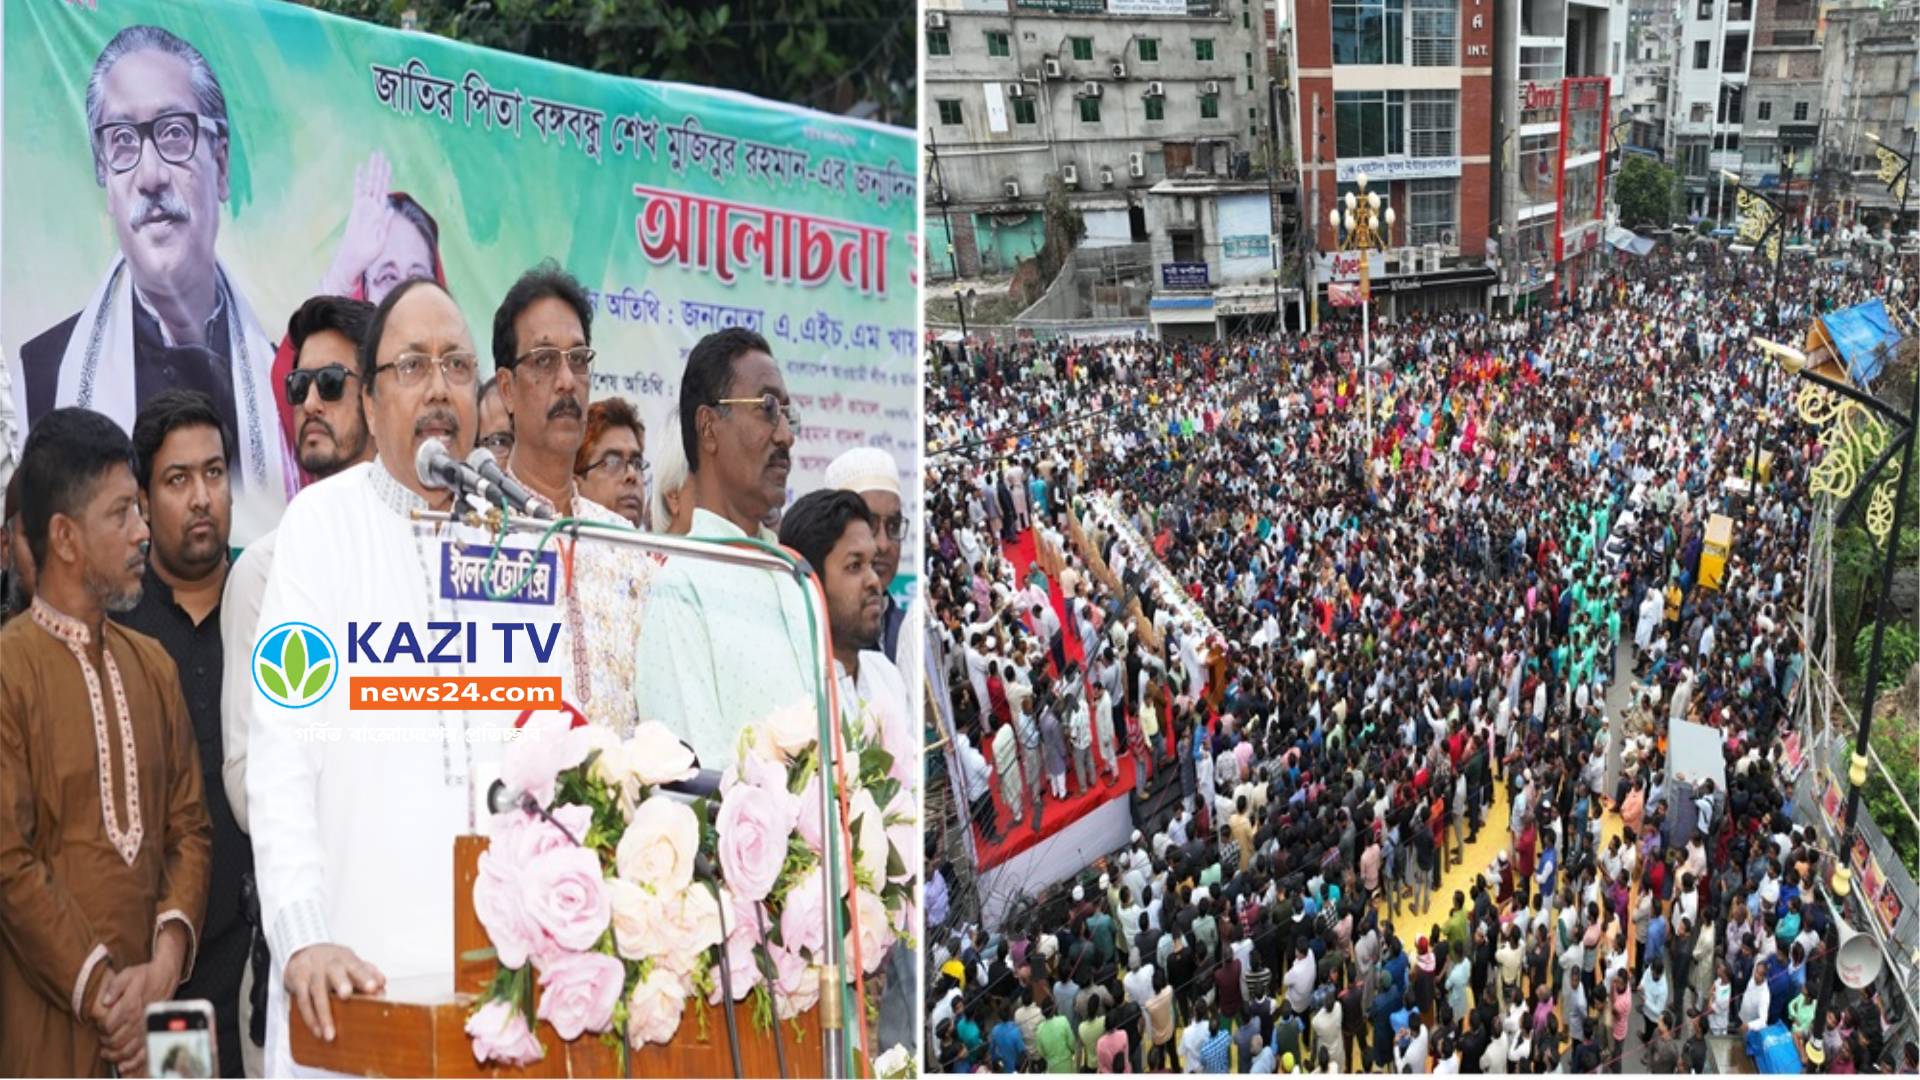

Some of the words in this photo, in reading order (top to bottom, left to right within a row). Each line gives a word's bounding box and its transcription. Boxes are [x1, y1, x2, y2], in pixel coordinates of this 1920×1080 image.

[1467, 44, 1488, 56] INT.
[372, 58, 455, 121] জাতির
[462, 71, 522, 136] পিতা
[530, 99, 603, 161] বঙ্গবন্ধু
[612, 115, 658, 157] শেখ
[667, 117, 737, 178] মুজিবুর
[746, 143, 847, 190] রহমান-এর
[634, 186, 889, 295] আলোচনা
[1332, 254, 1360, 278] Ape
[605, 286, 660, 324] অতিথি
[681, 300, 765, 333] জননেতা
[622, 370, 663, 397] অতিথি
